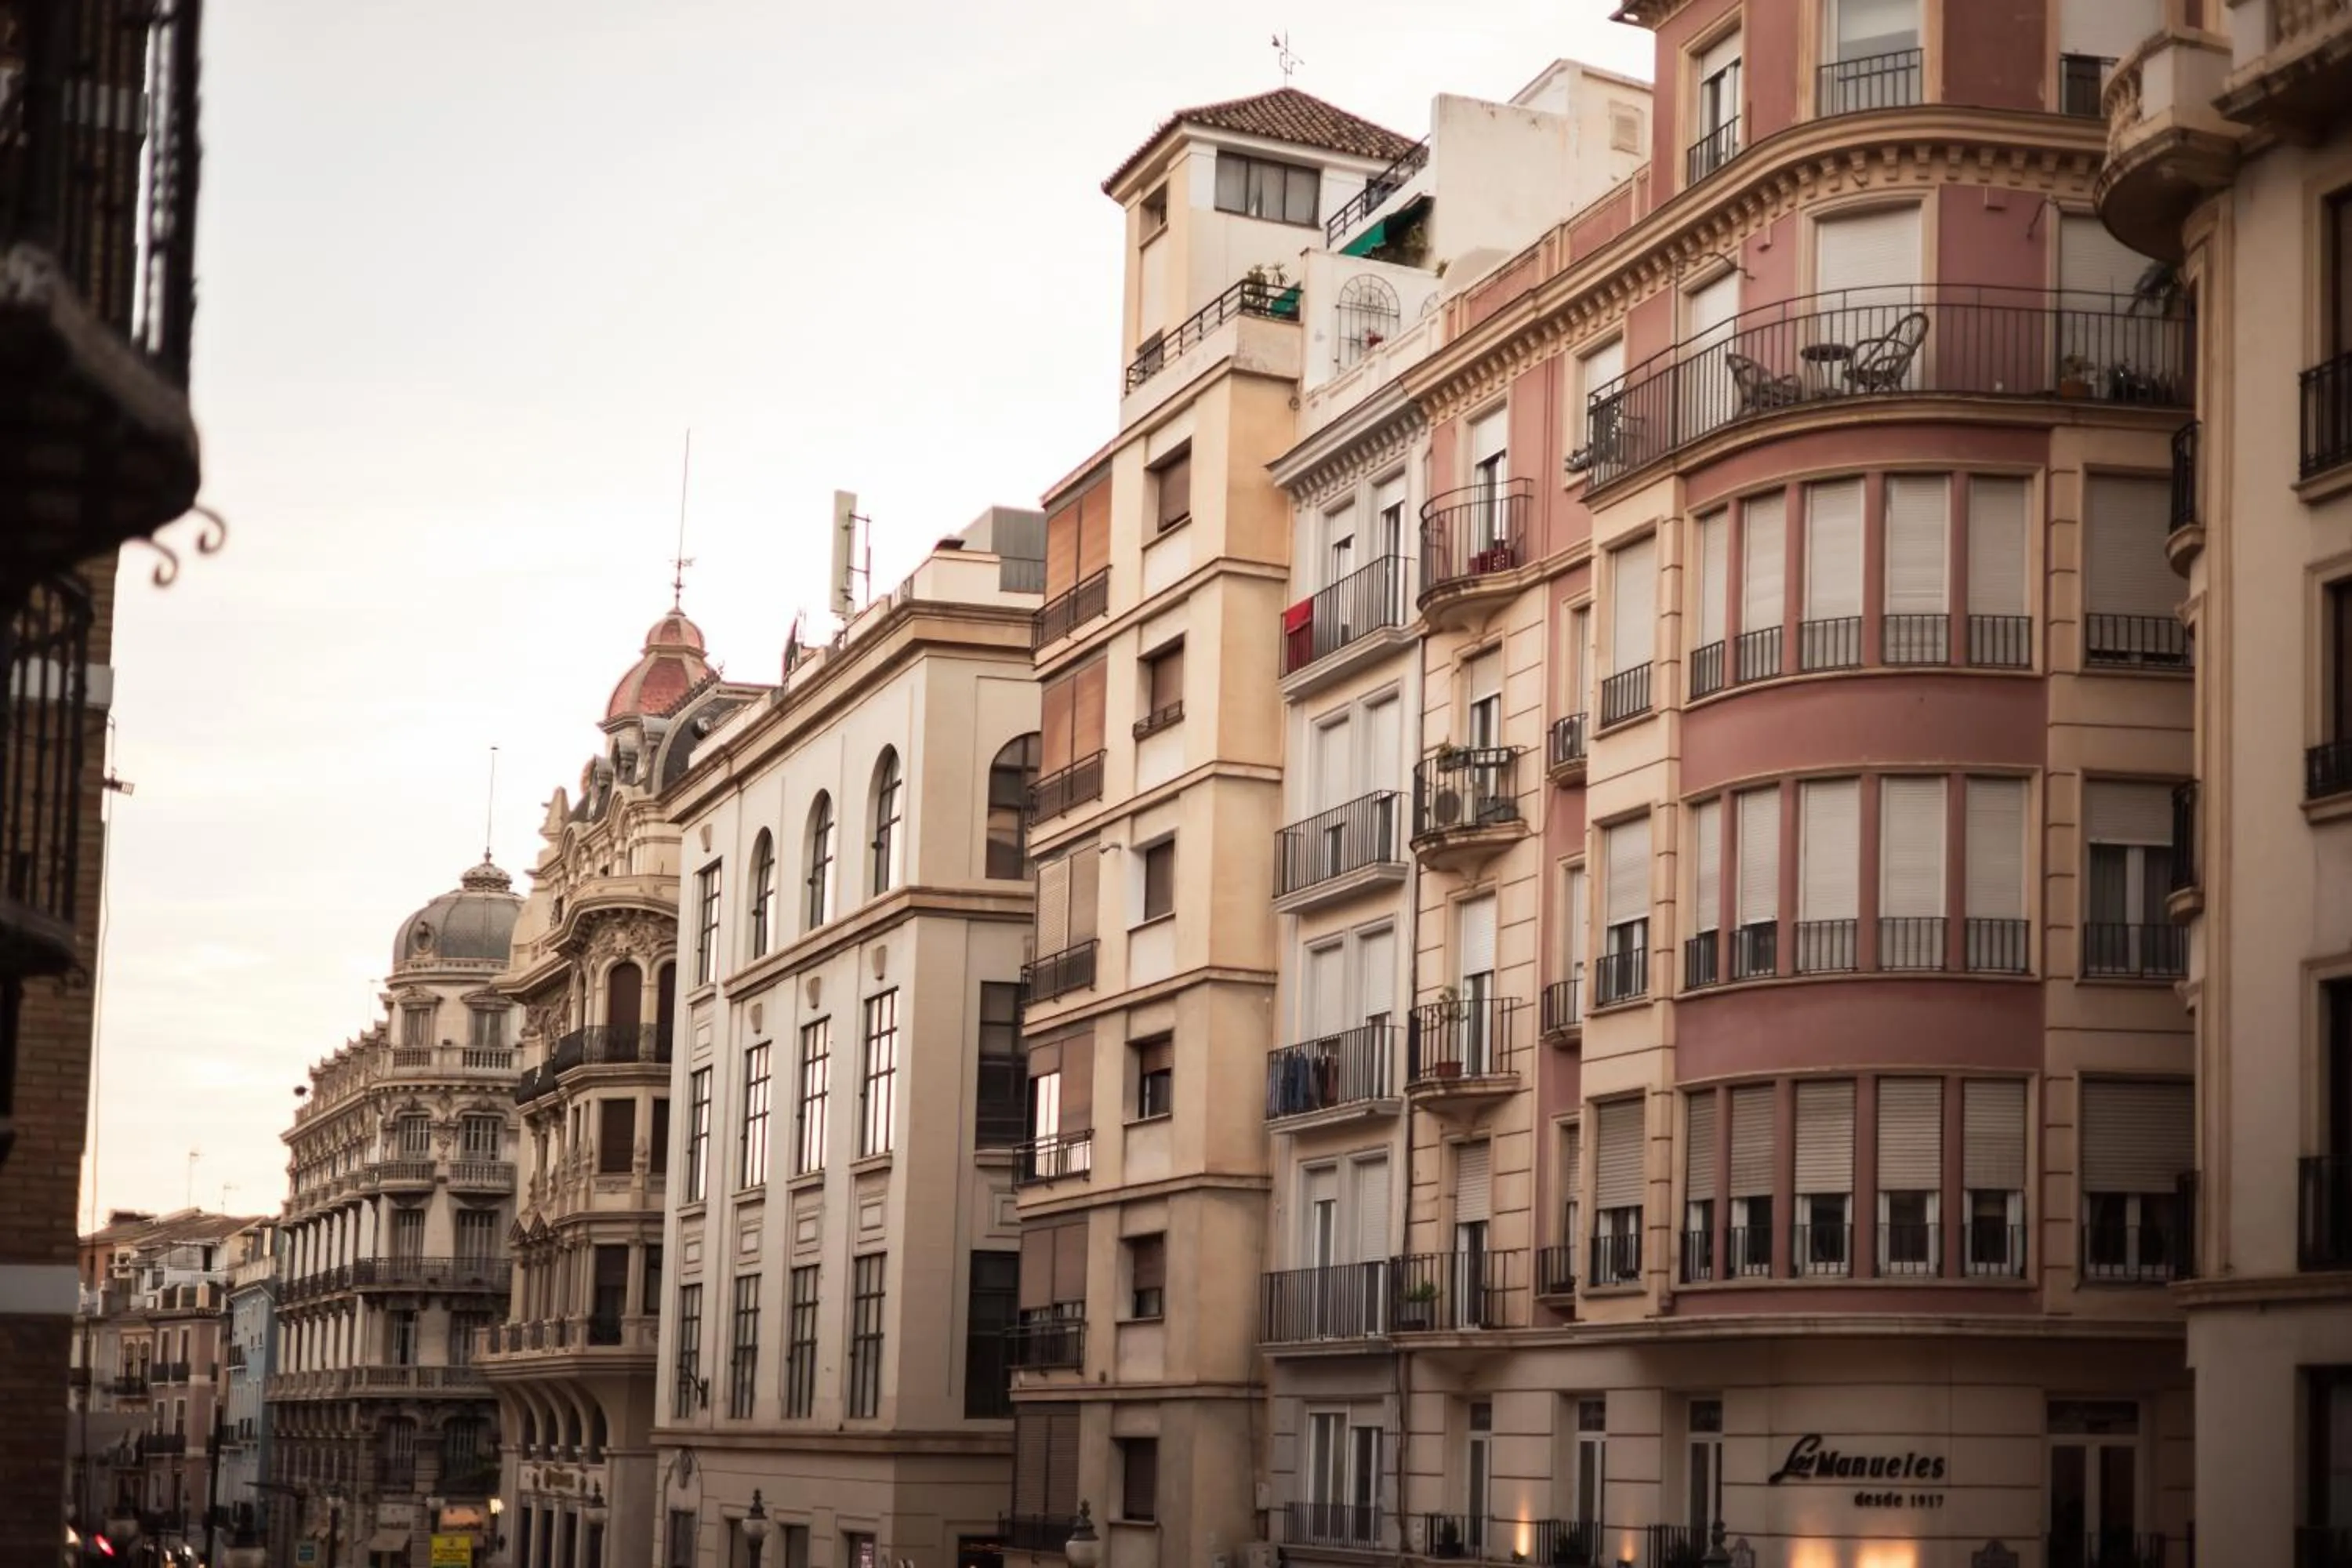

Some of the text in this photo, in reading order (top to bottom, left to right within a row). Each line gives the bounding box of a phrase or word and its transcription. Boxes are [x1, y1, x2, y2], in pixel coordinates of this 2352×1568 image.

[1815, 1450, 1945, 1480] Manueles
[1854, 1491, 1944, 1508] desde 1917
